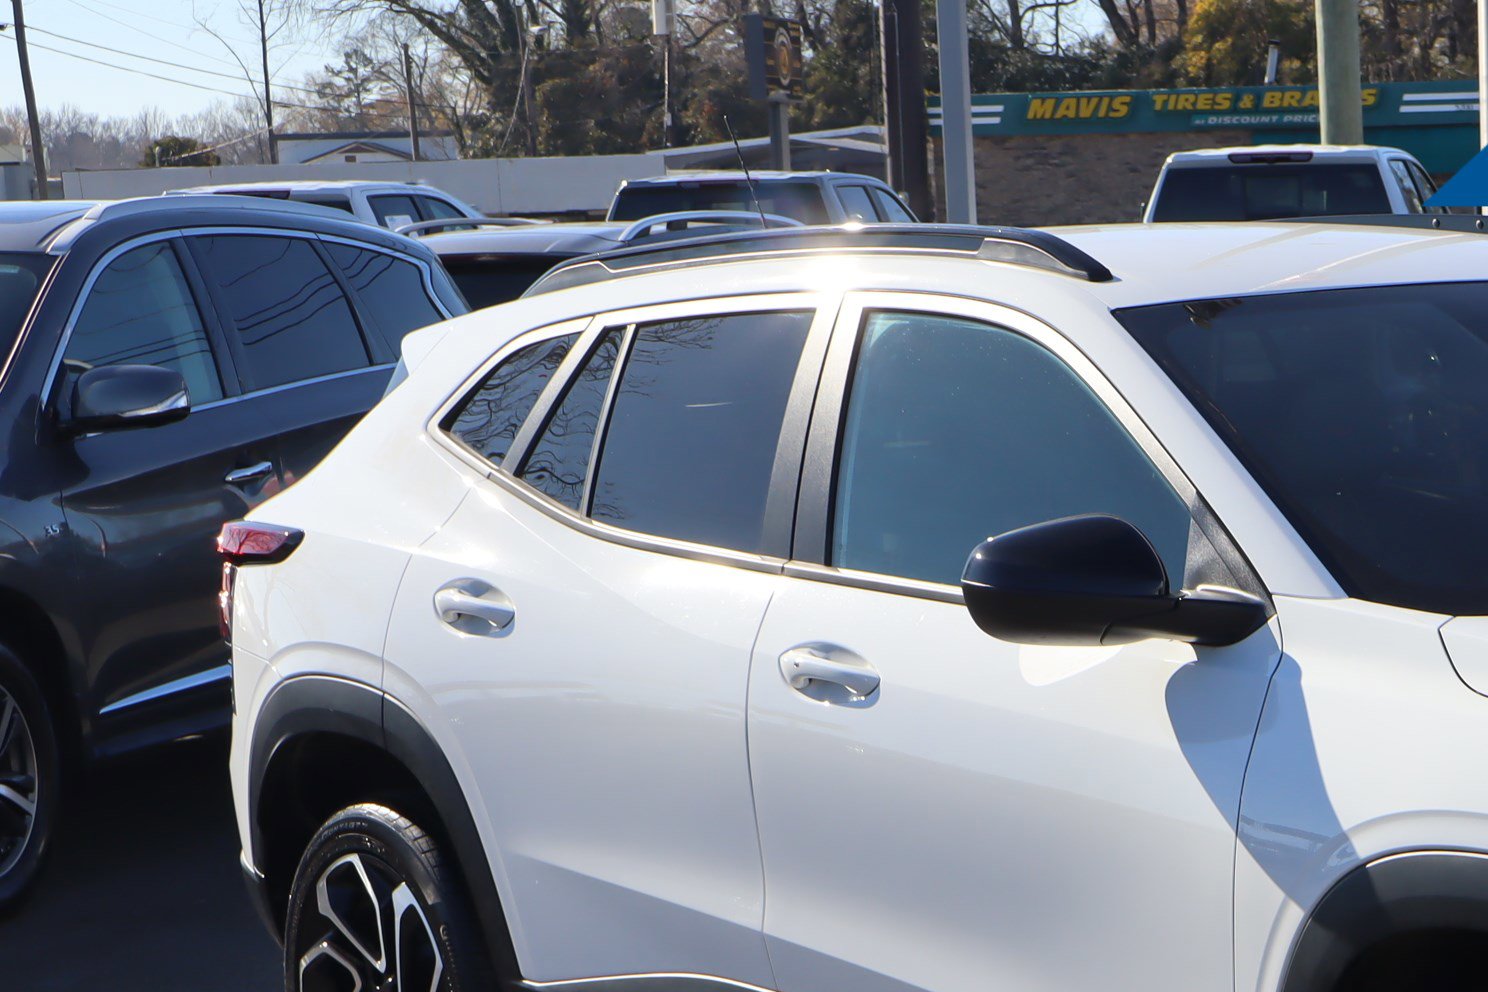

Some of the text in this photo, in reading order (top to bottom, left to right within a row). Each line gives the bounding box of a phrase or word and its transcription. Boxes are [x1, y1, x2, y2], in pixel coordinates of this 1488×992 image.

[1027, 88, 1378, 120] MAVIS TIRES & BRAS
[1207, 114, 1279, 125] DISCOUNT
